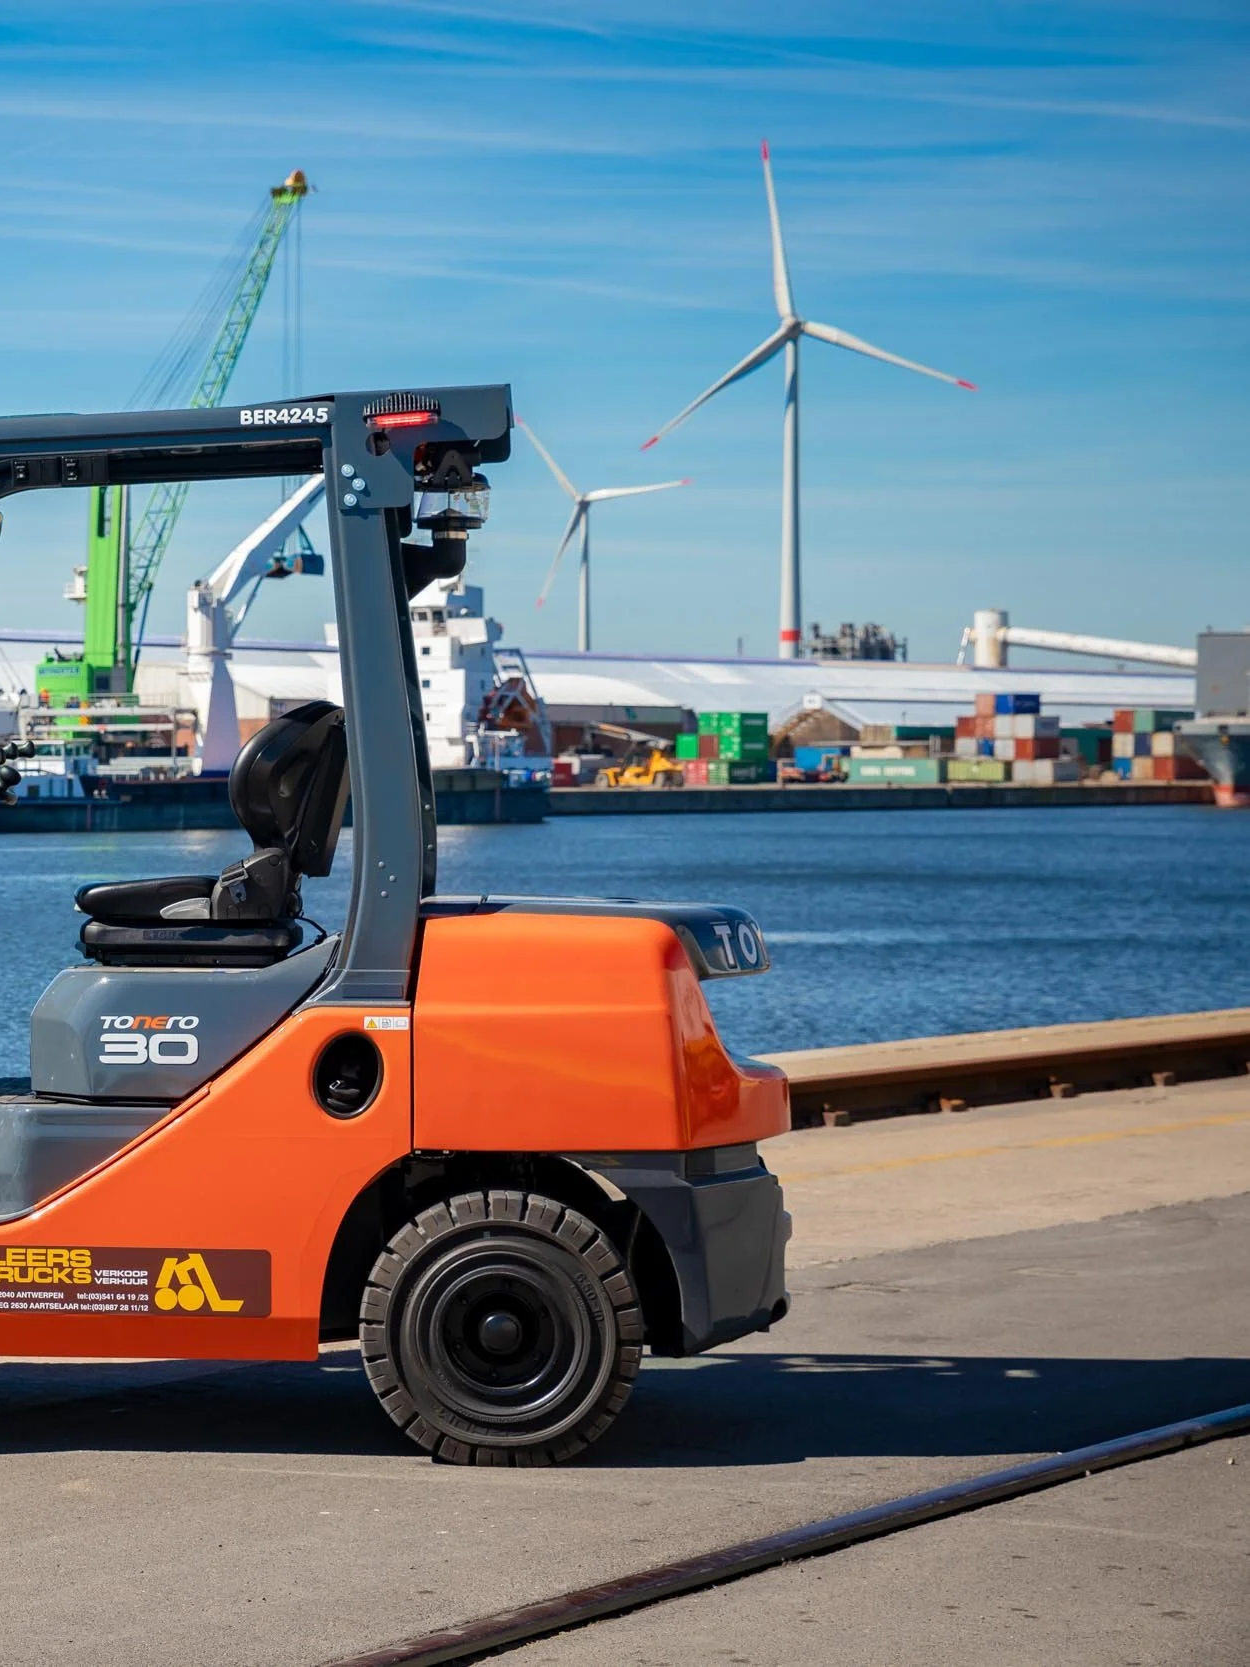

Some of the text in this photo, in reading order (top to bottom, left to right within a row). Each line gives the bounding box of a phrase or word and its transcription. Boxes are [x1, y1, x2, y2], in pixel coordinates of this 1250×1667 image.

[240, 407, 329, 425] BER4245
[99, 1033, 199, 1064] 30
[94, 1269, 149, 1277] VERKOOP
[94, 1277, 149, 1286] VERHUUR
[16, 1291, 64, 1299] ANTWERPEN
[10, 1301, 28, 1309] 2630
[29, 1302, 79, 1310] AARTSELAAR
